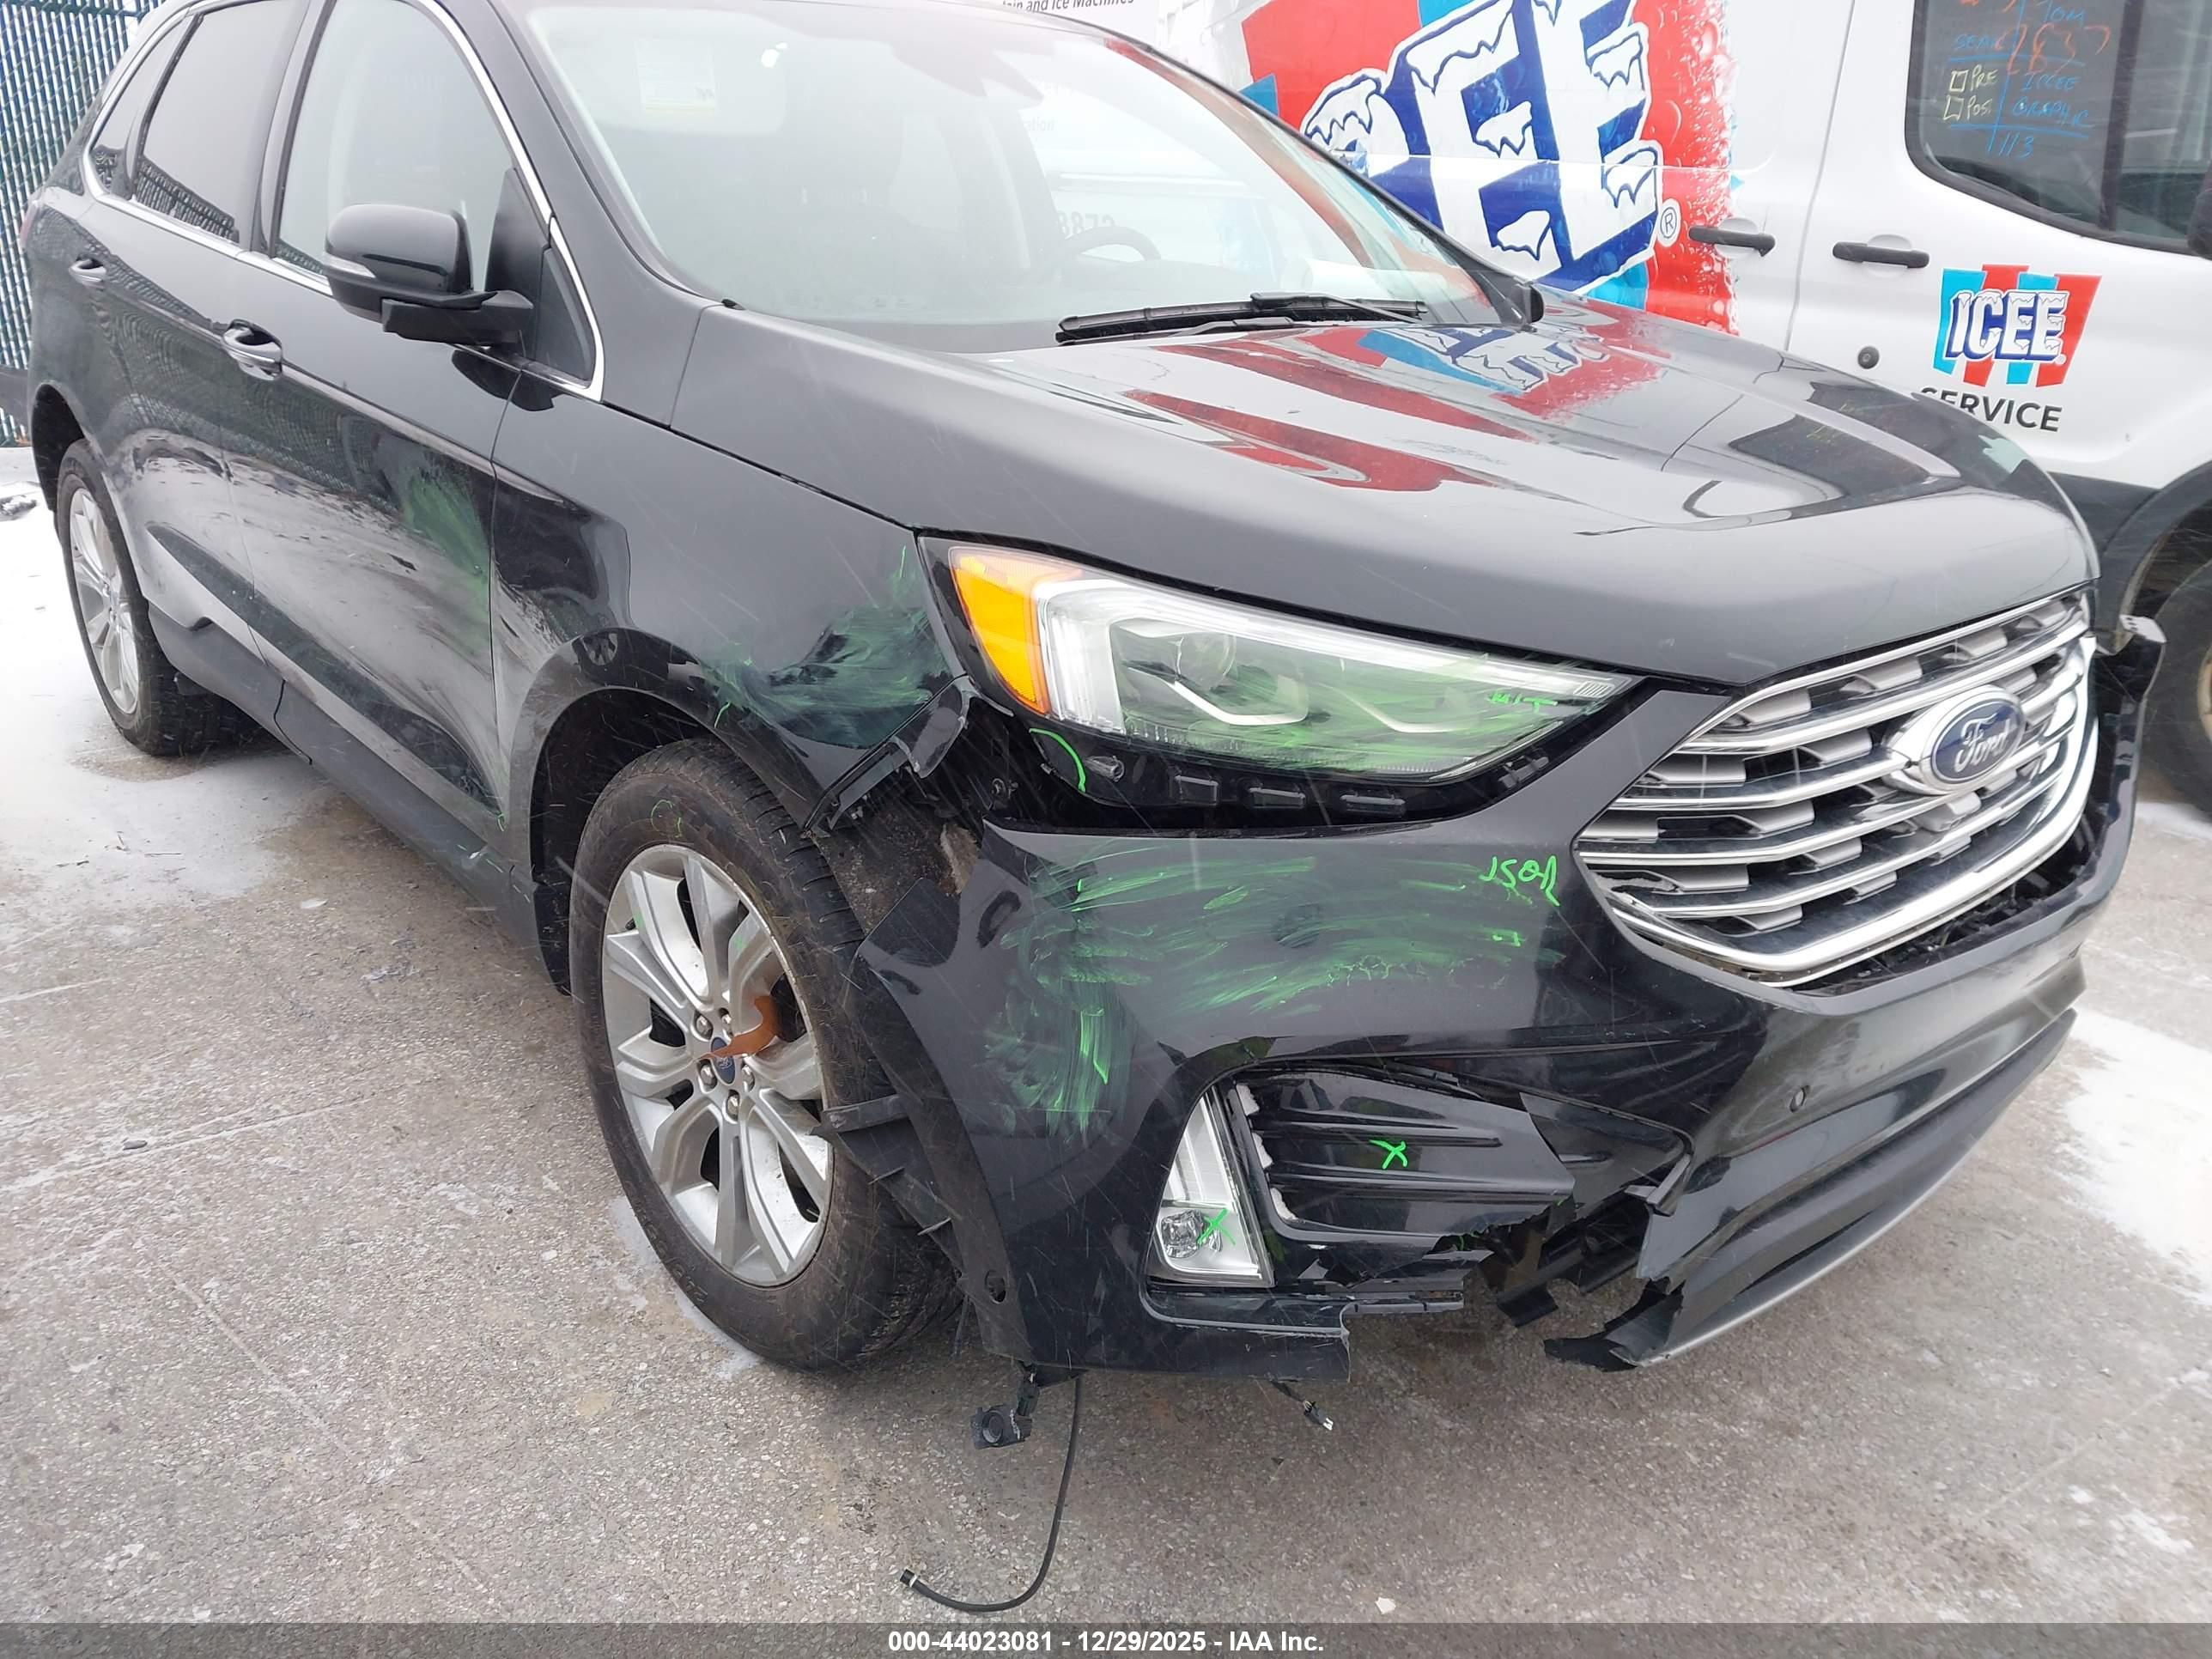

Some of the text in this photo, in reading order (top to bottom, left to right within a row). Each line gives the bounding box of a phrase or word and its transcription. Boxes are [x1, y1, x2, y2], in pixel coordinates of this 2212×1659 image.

[1025, 0, 1048, 12] and
[1051, 0, 1070, 10] Ice
[1944, 289, 2070, 362] ICEE
[1954, 712, 2011, 773] Ford
